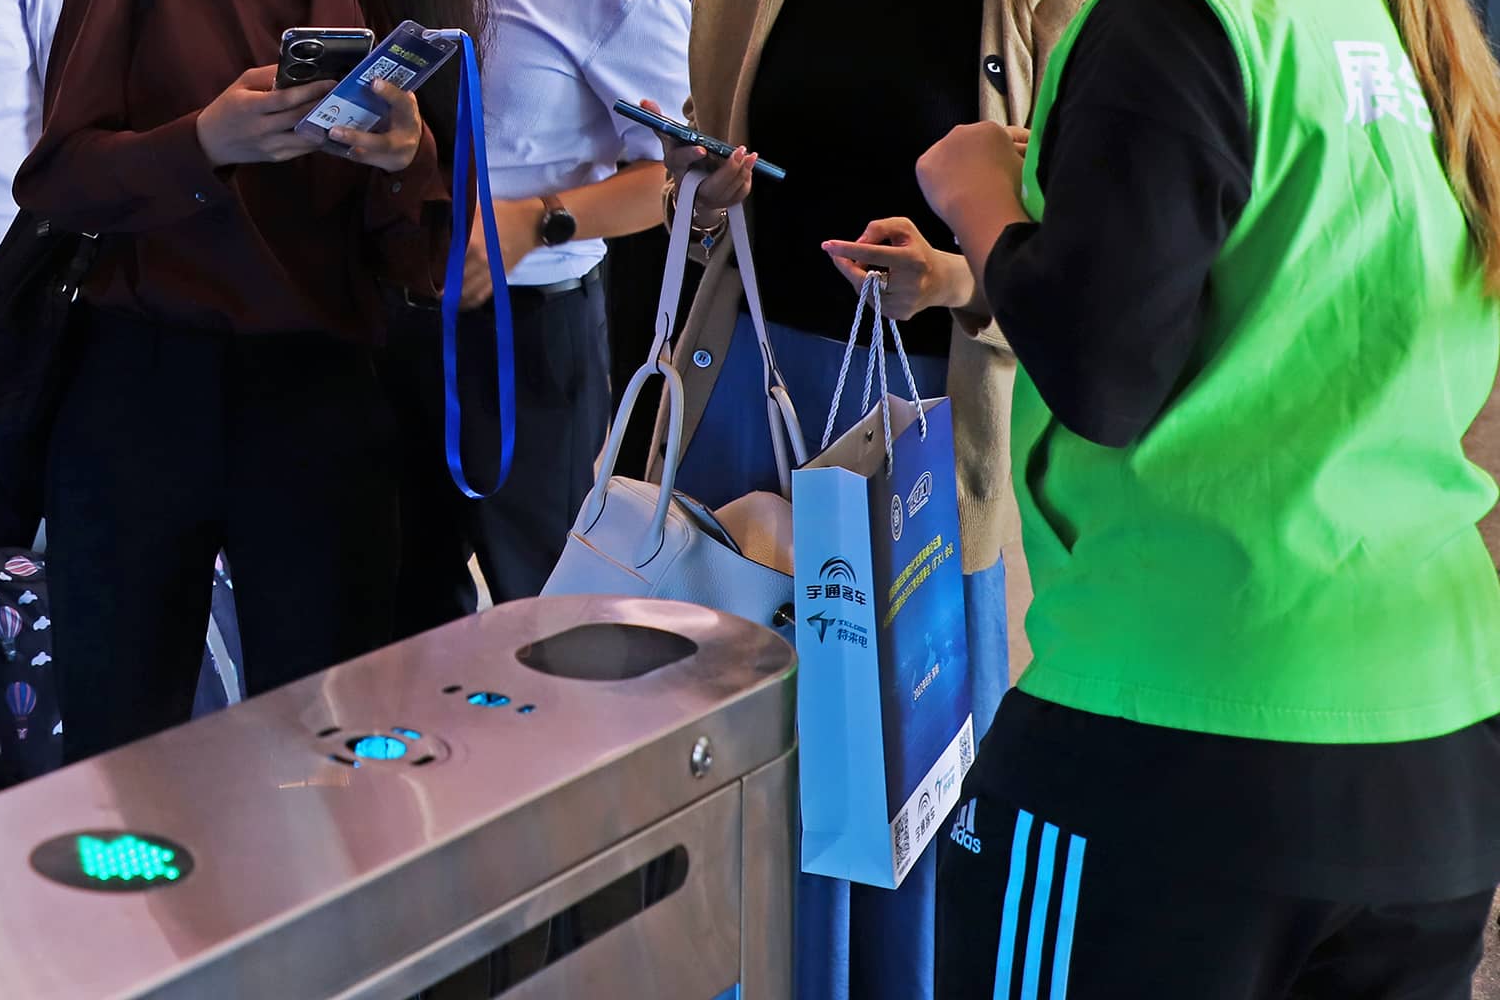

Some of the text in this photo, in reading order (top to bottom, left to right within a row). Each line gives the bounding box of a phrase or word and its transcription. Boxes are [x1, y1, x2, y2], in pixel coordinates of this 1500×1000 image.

[806, 584, 867, 606] 宇通客车
[837, 628, 868, 649] 特来电
